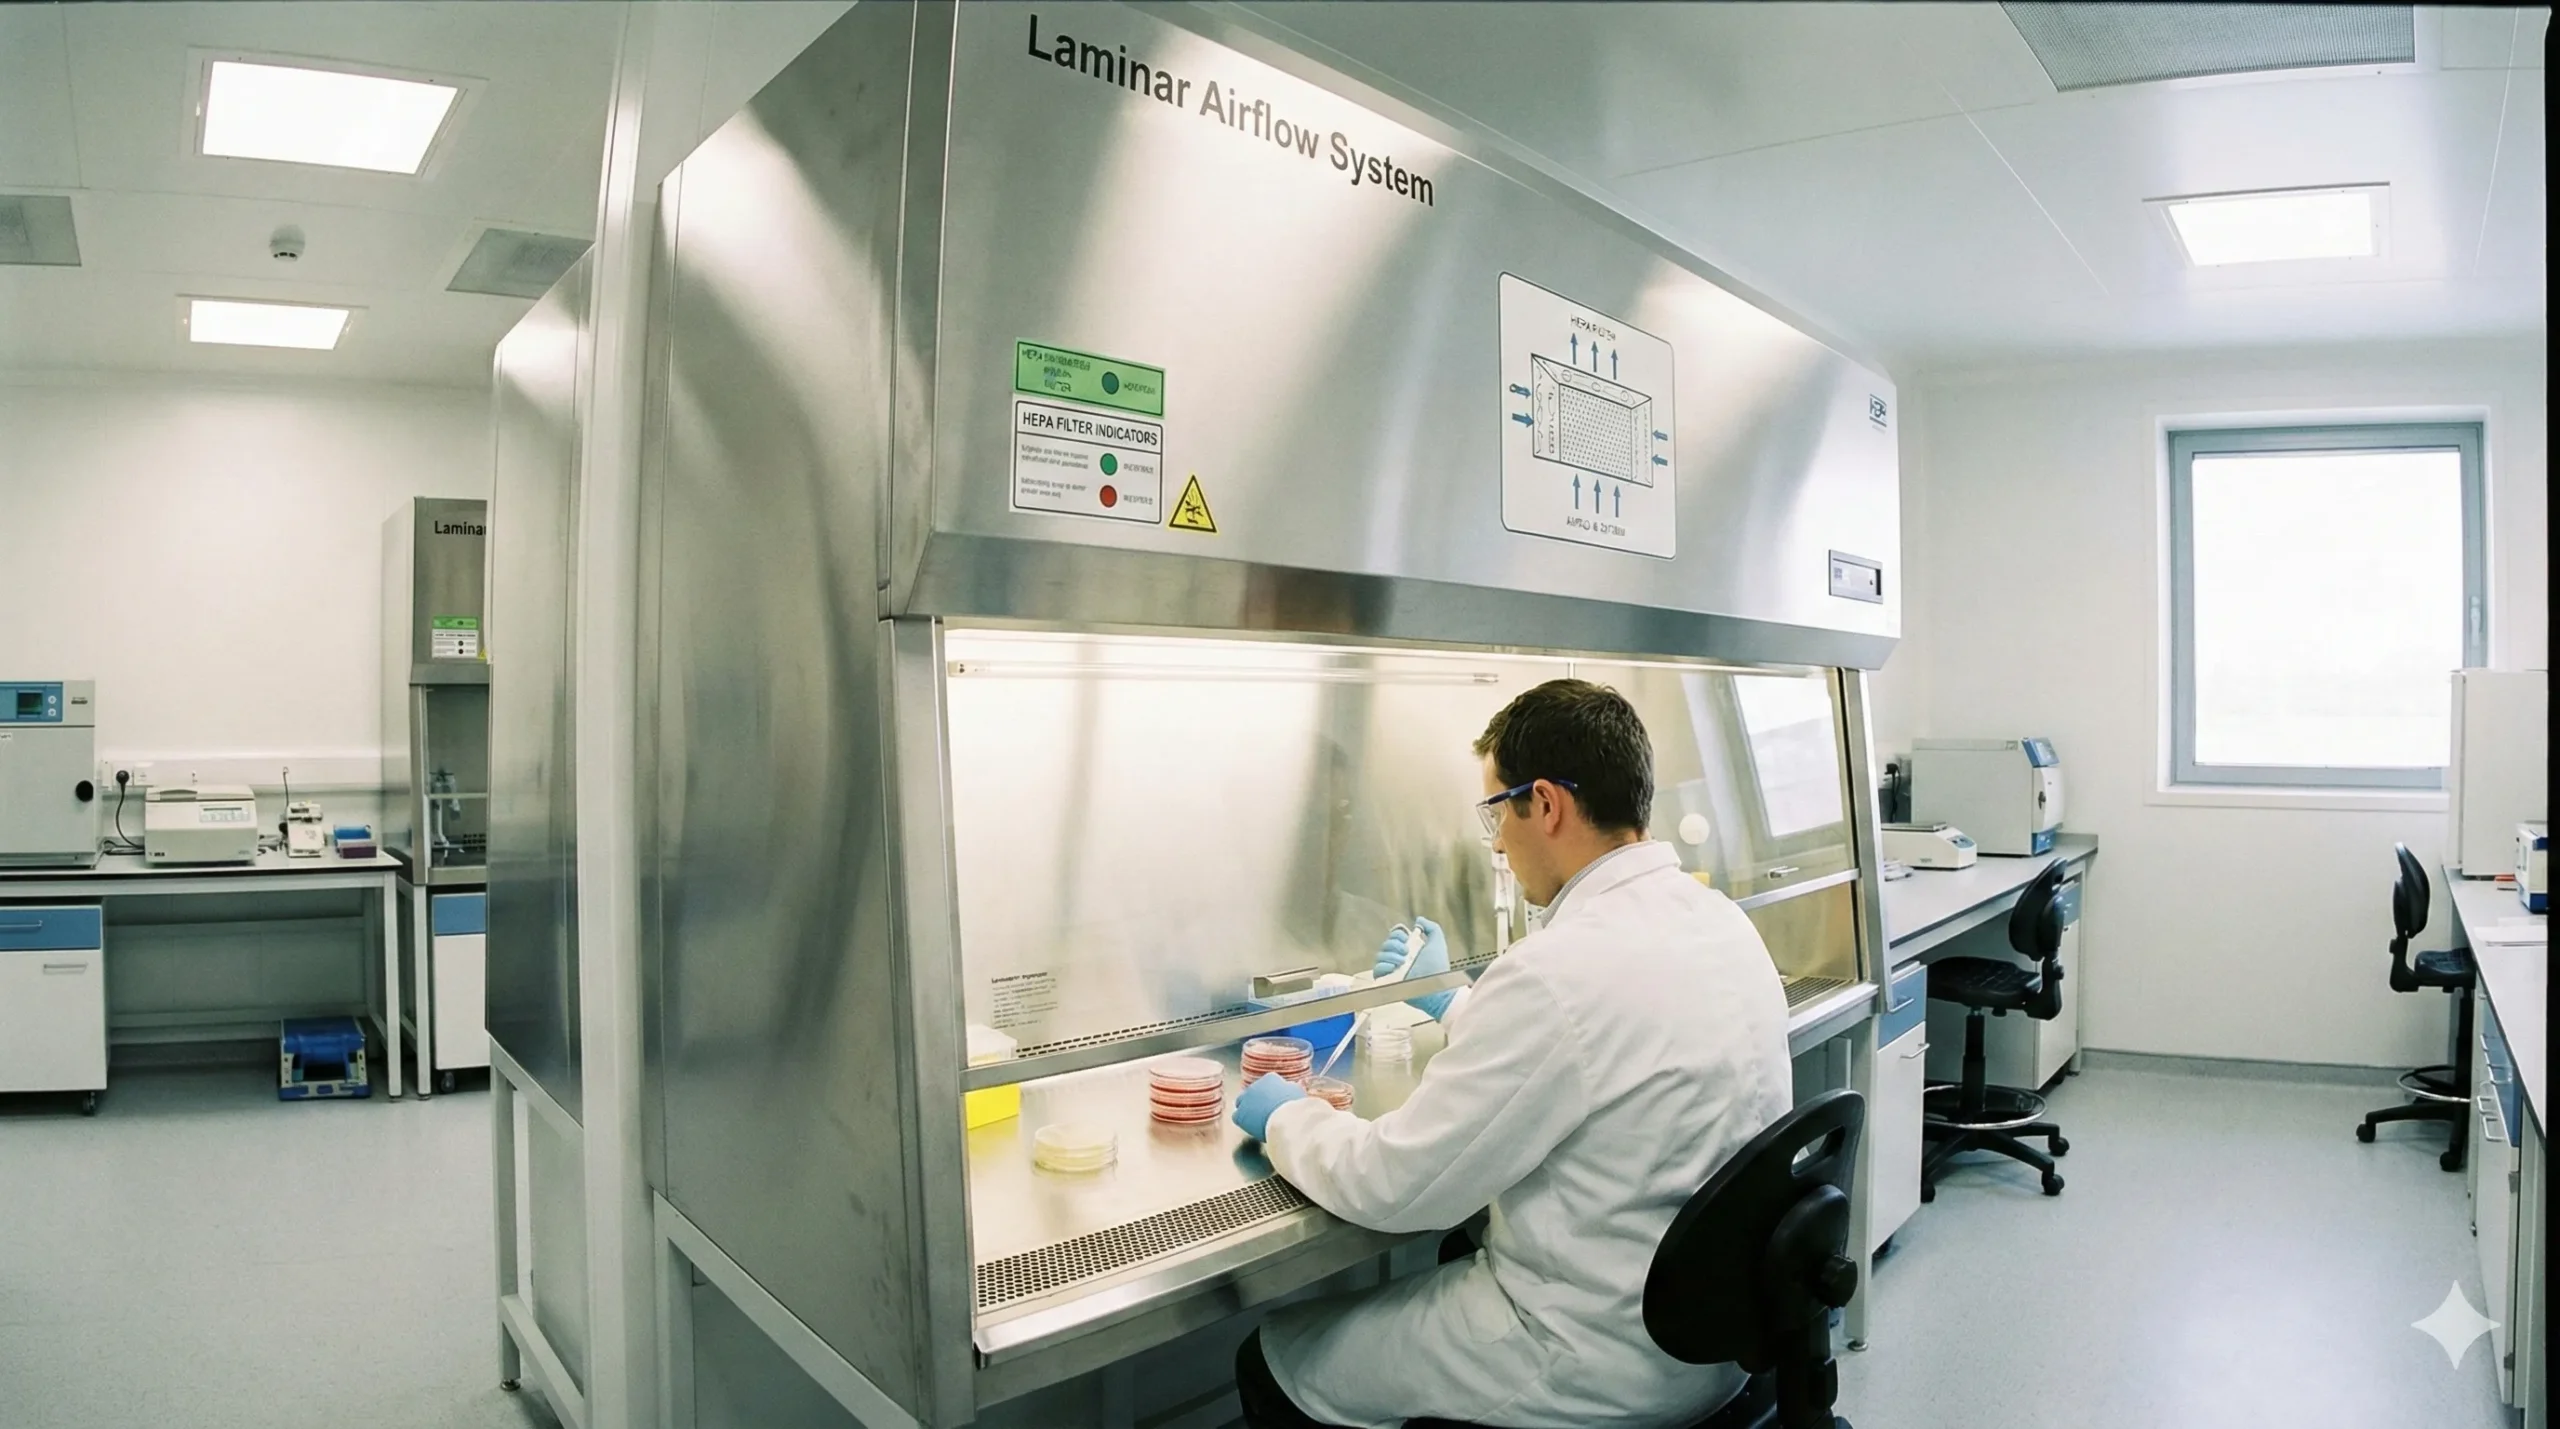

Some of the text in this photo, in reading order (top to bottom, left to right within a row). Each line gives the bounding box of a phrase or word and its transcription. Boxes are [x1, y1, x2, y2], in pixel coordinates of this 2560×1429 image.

[1027, 13, 1434, 207] Laminar Airflow System
[1023, 411, 1158, 446] HEPA FILTER INDICATORS
